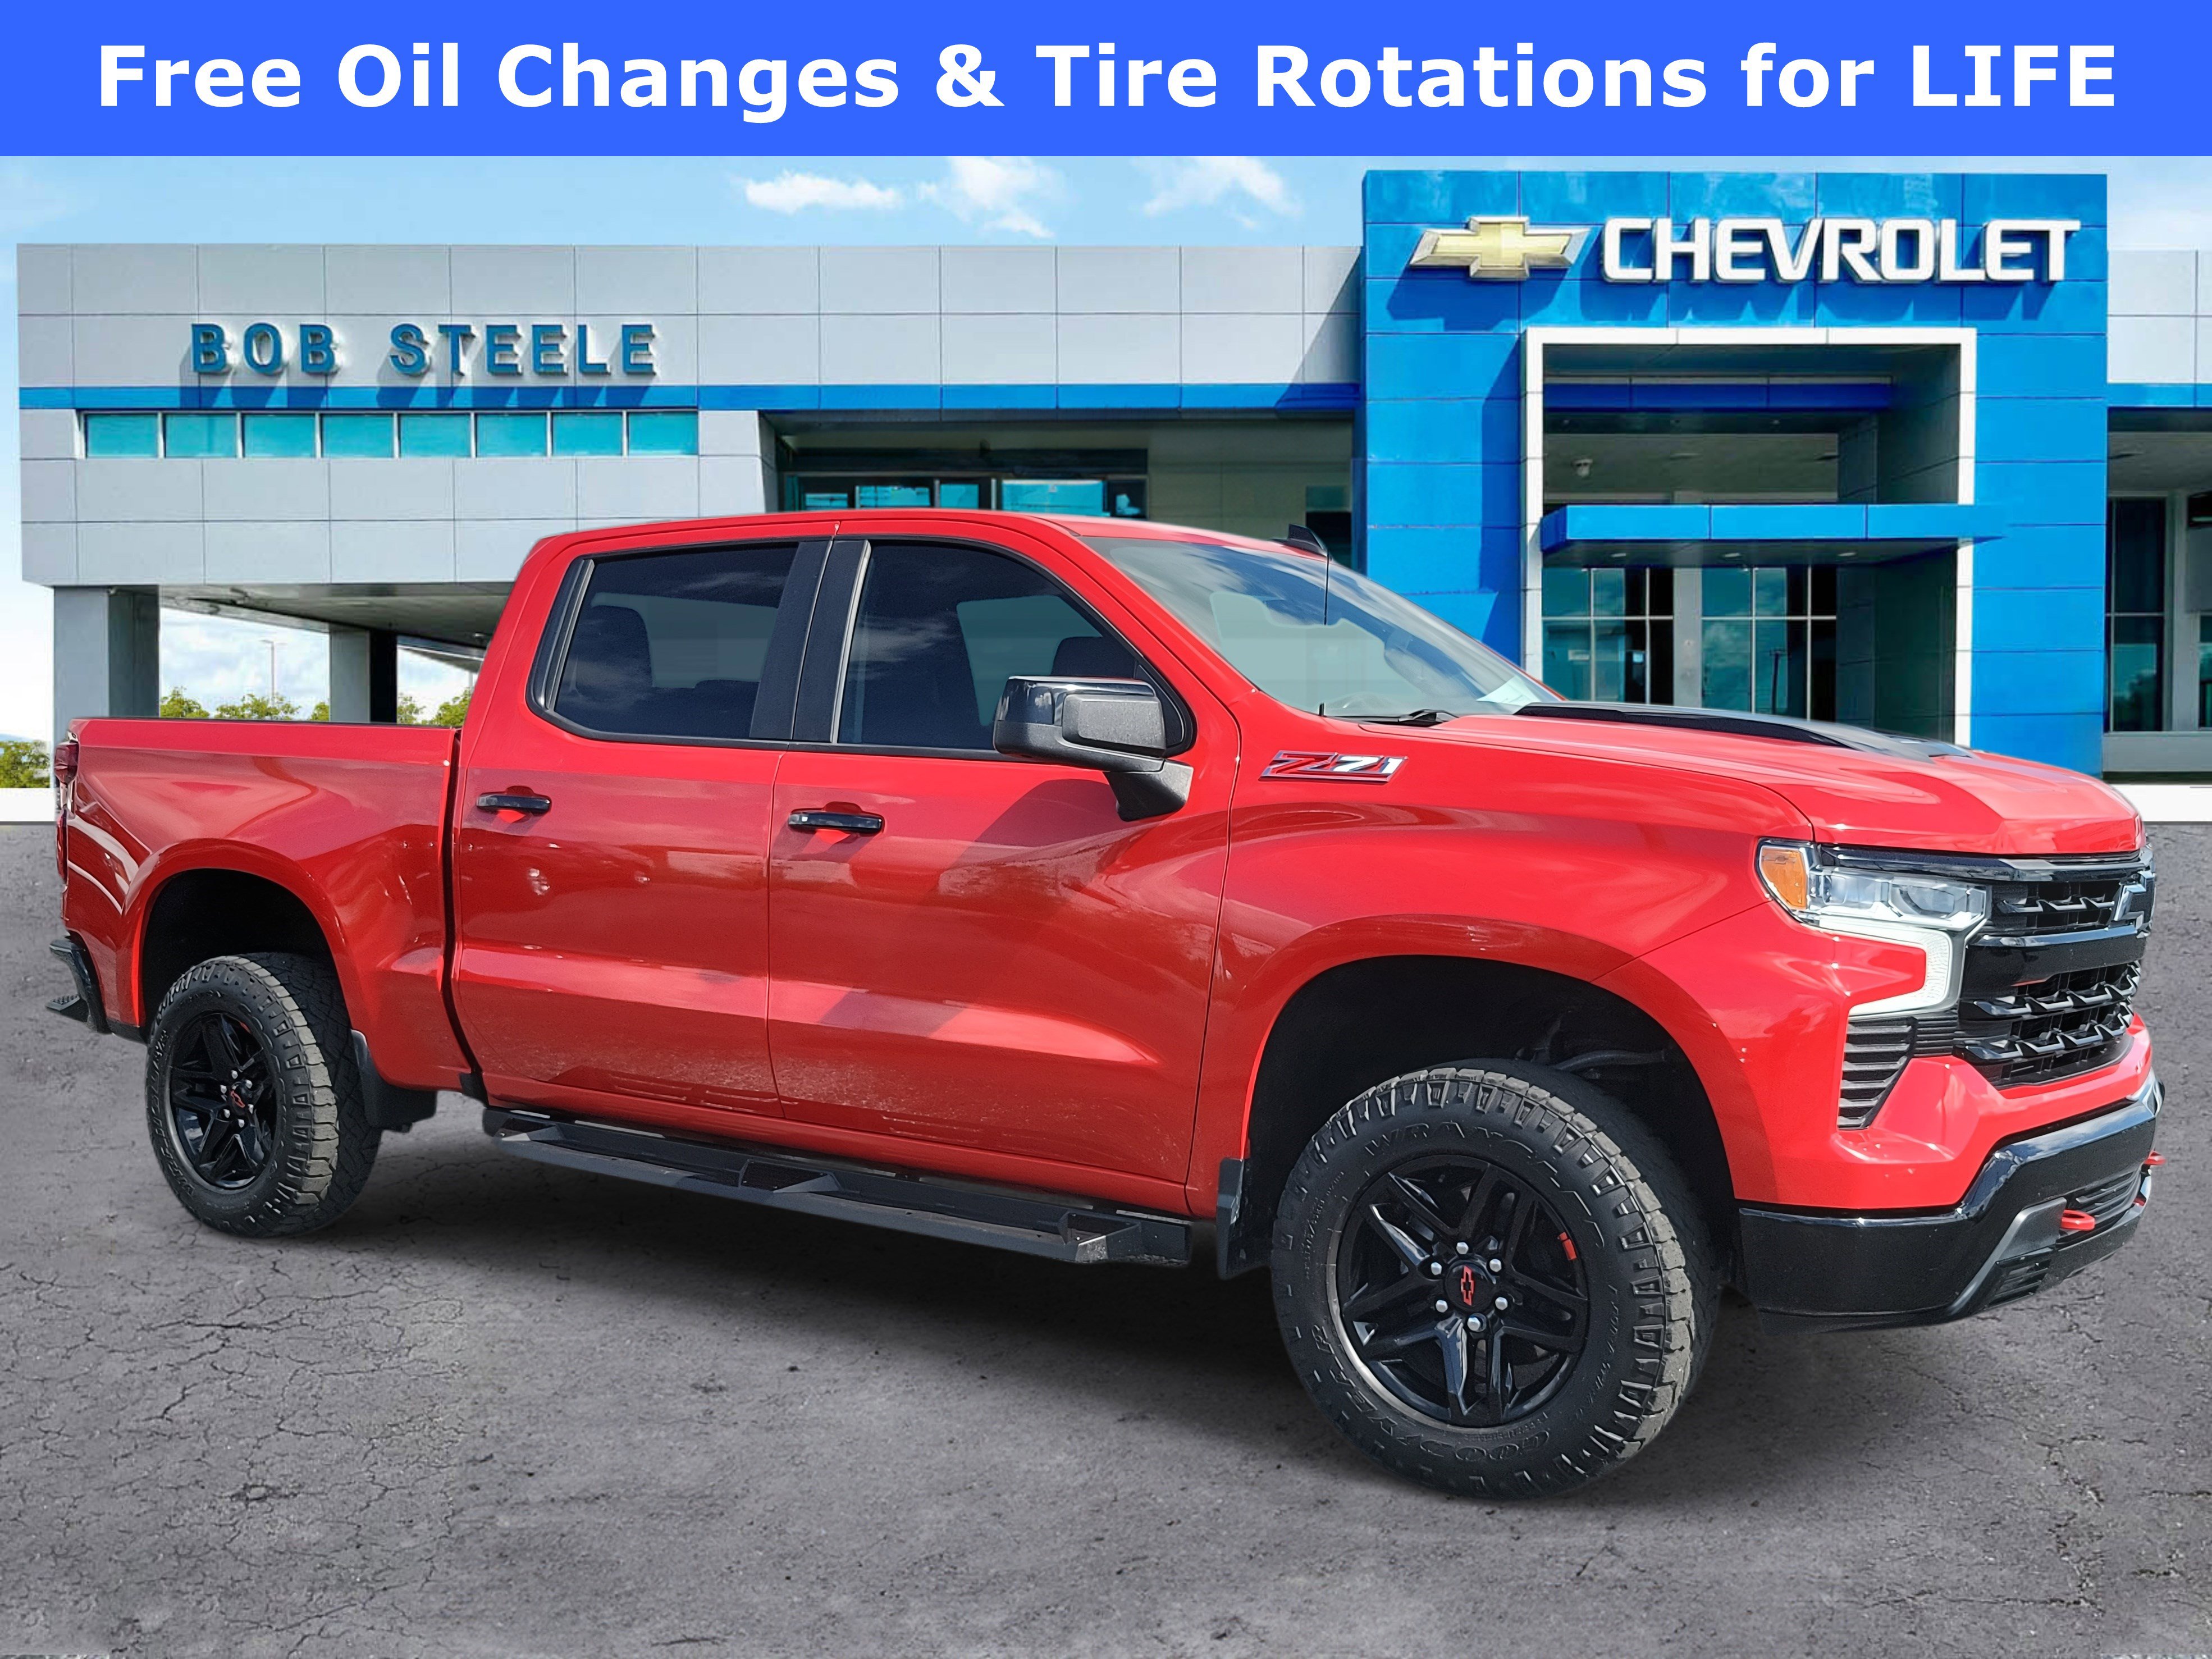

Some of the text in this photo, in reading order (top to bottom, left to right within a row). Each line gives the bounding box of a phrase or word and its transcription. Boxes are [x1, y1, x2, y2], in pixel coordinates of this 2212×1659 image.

[1601, 217, 2082, 284] CHEVROLET
[191, 322, 656, 376] BOB STEELE
[1258, 749, 1408, 784] Z71
